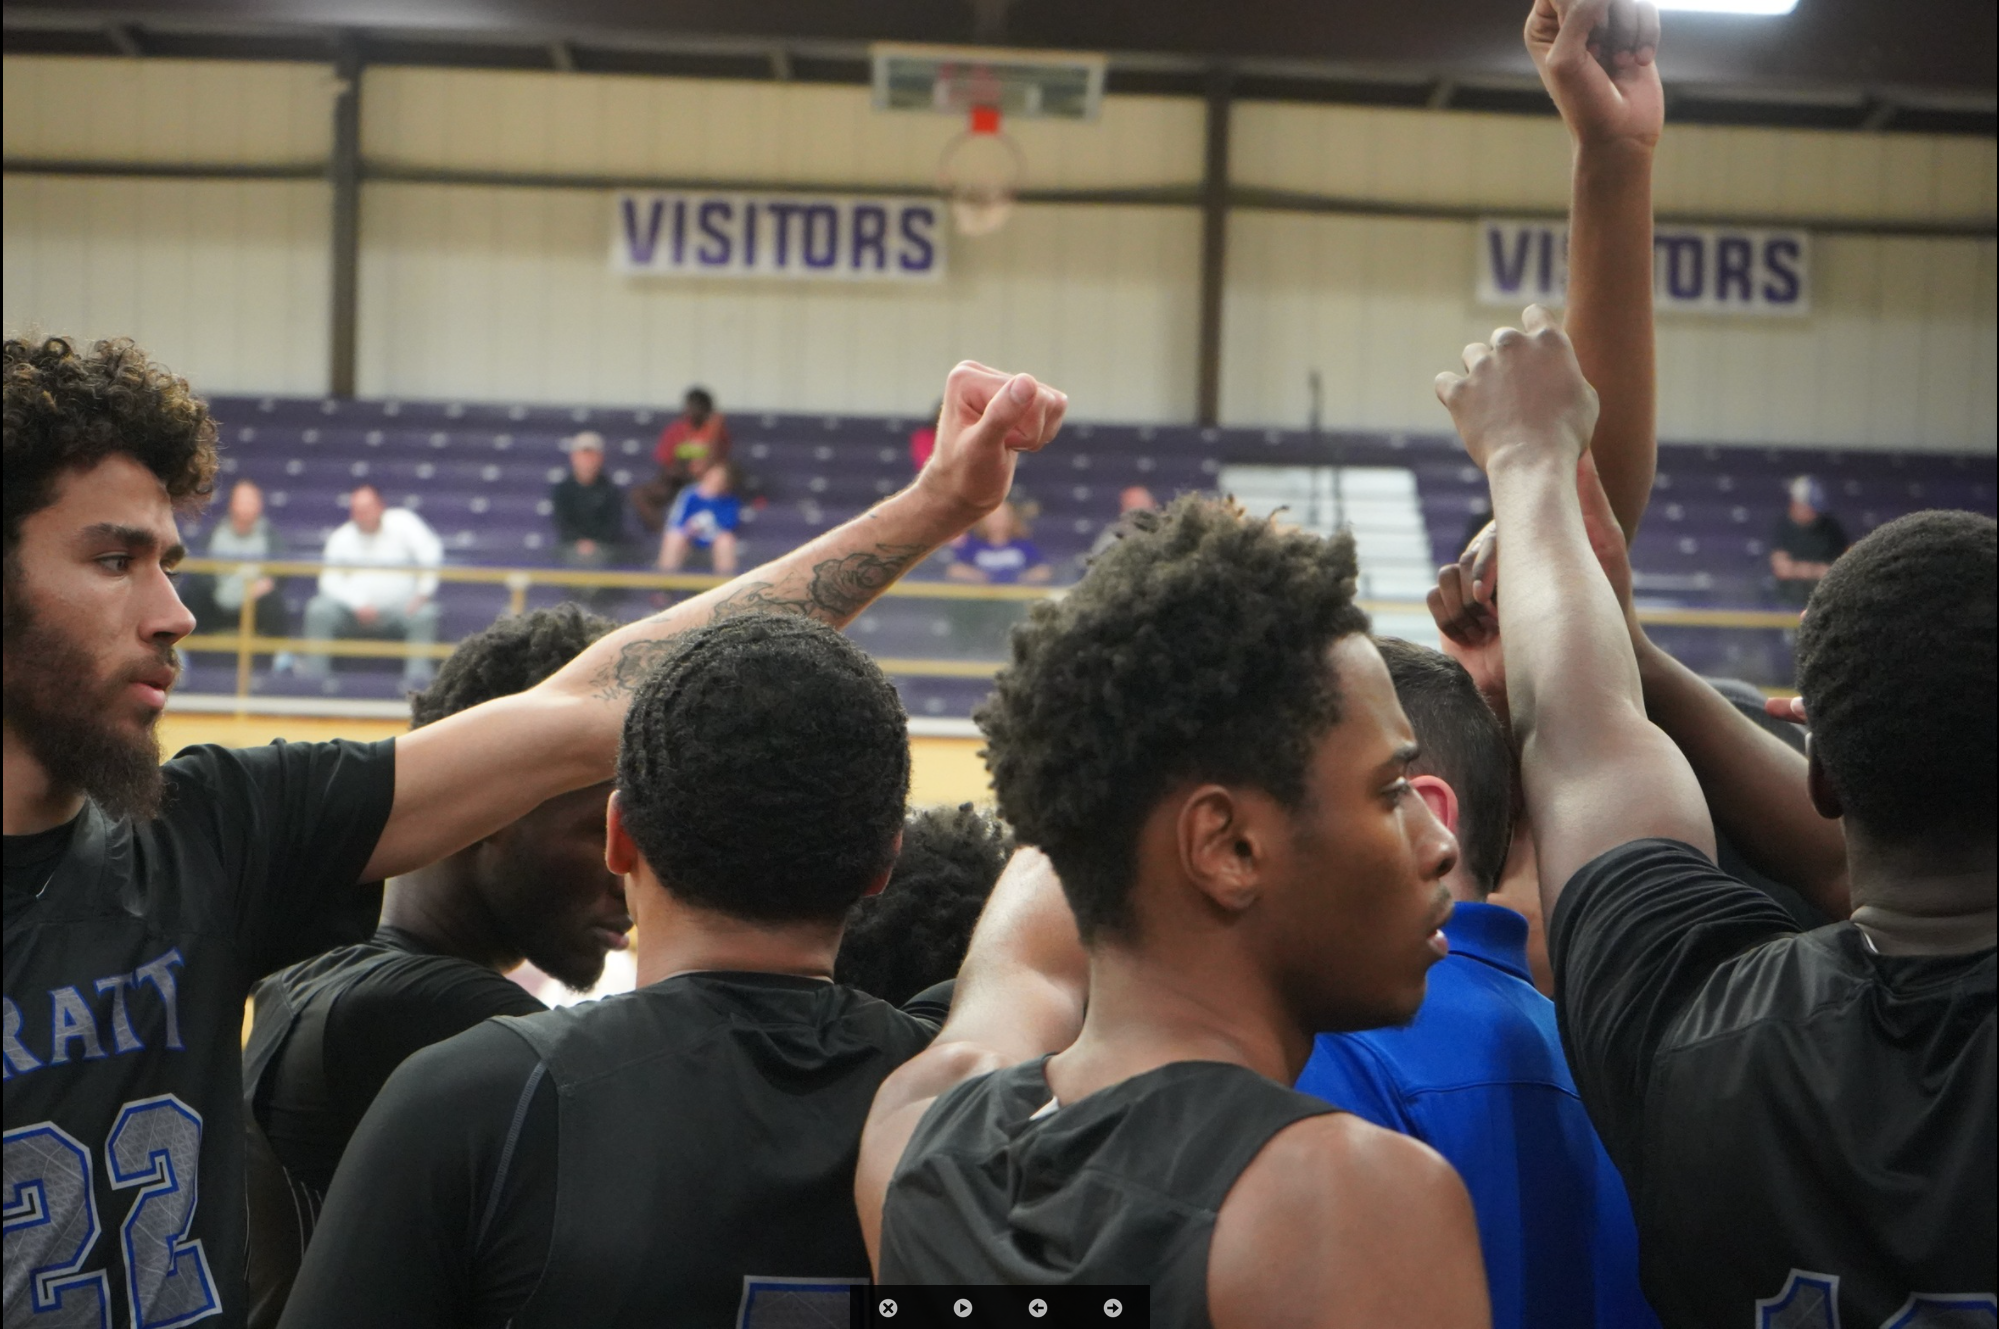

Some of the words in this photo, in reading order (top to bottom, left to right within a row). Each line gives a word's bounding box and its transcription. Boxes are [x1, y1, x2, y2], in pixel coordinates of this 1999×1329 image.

[622, 198, 935, 271] VISITORS
[1488, 226, 1801, 305] VIORS
[3, 1093, 223, 1329] 22
